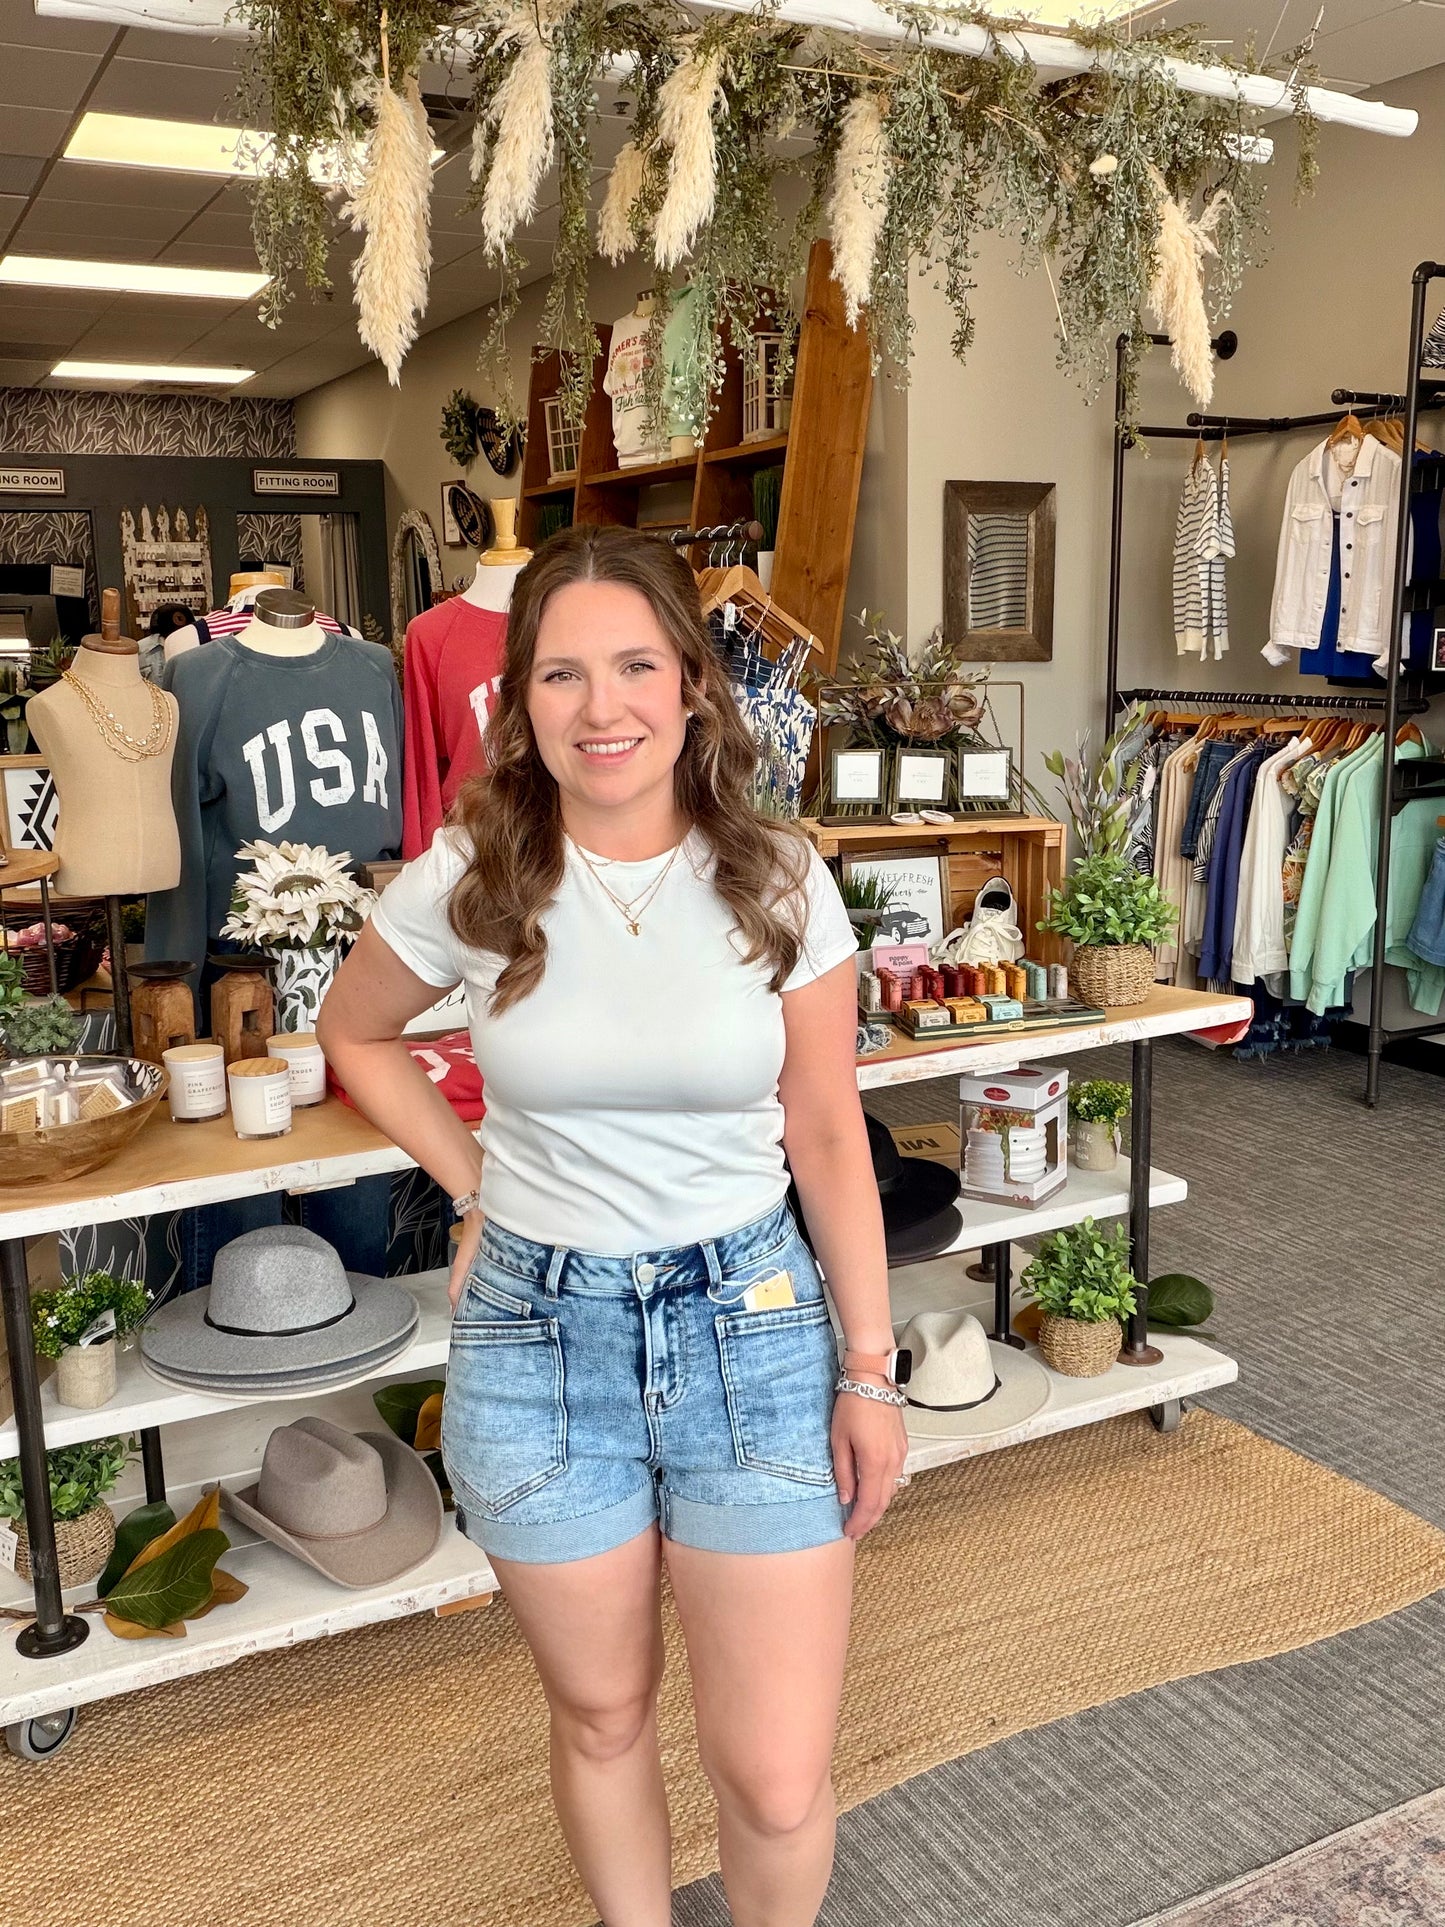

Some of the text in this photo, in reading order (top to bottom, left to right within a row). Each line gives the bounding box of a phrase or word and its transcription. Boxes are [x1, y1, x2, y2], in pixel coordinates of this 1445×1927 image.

[23, 475, 58, 485] ROOM
[259, 477, 334, 488] FITTING ROOM
[242, 708, 389, 834] USA
[902, 872, 934, 886] FRESH
